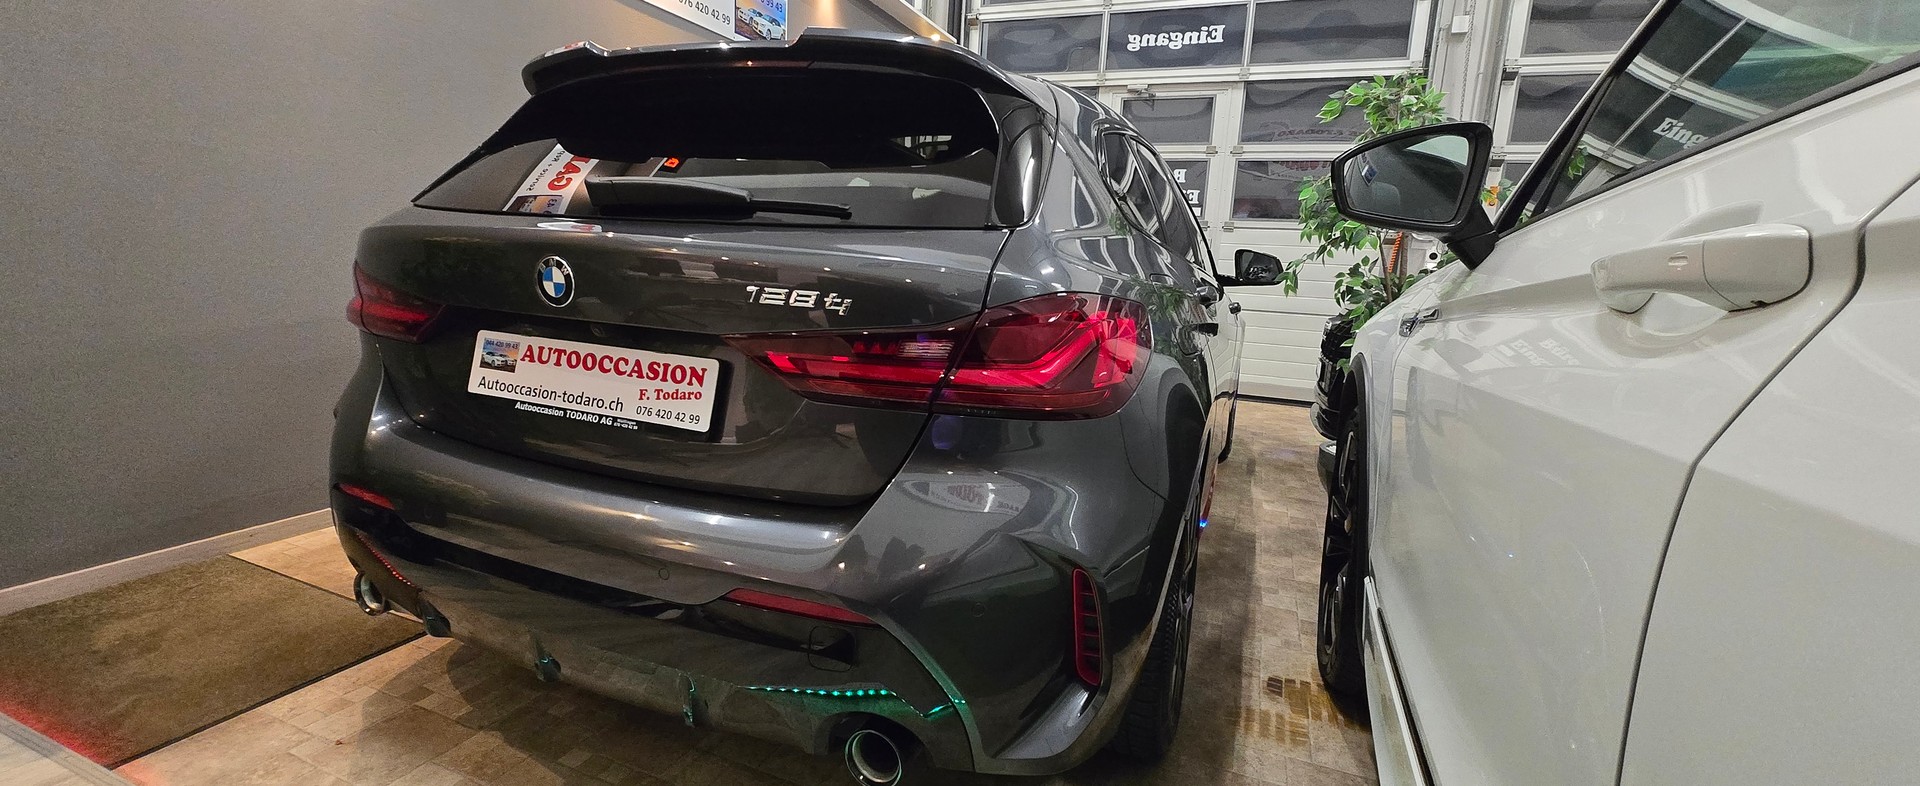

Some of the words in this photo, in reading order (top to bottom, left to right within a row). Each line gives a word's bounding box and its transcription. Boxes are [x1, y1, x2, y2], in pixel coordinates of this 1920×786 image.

[694, 2, 710, 16] 420
[710, 8, 720, 21] 42
[721, 13, 731, 26] 99
[519, 344, 707, 388] AUTOOCCASION
[477, 376, 624, 413] Autooccasion-todaro.ch
[638, 389, 650, 401] F.
[654, 388, 703, 401] Todaro
[514, 401, 564, 417] Autooccasion
[565, 410, 599, 423] TODARO
[599, 415, 613, 426] AG
[636, 405, 653, 417] 076
[655, 408, 673, 420] 420
[674, 411, 686, 423] 42
[688, 413, 701, 425] 99
